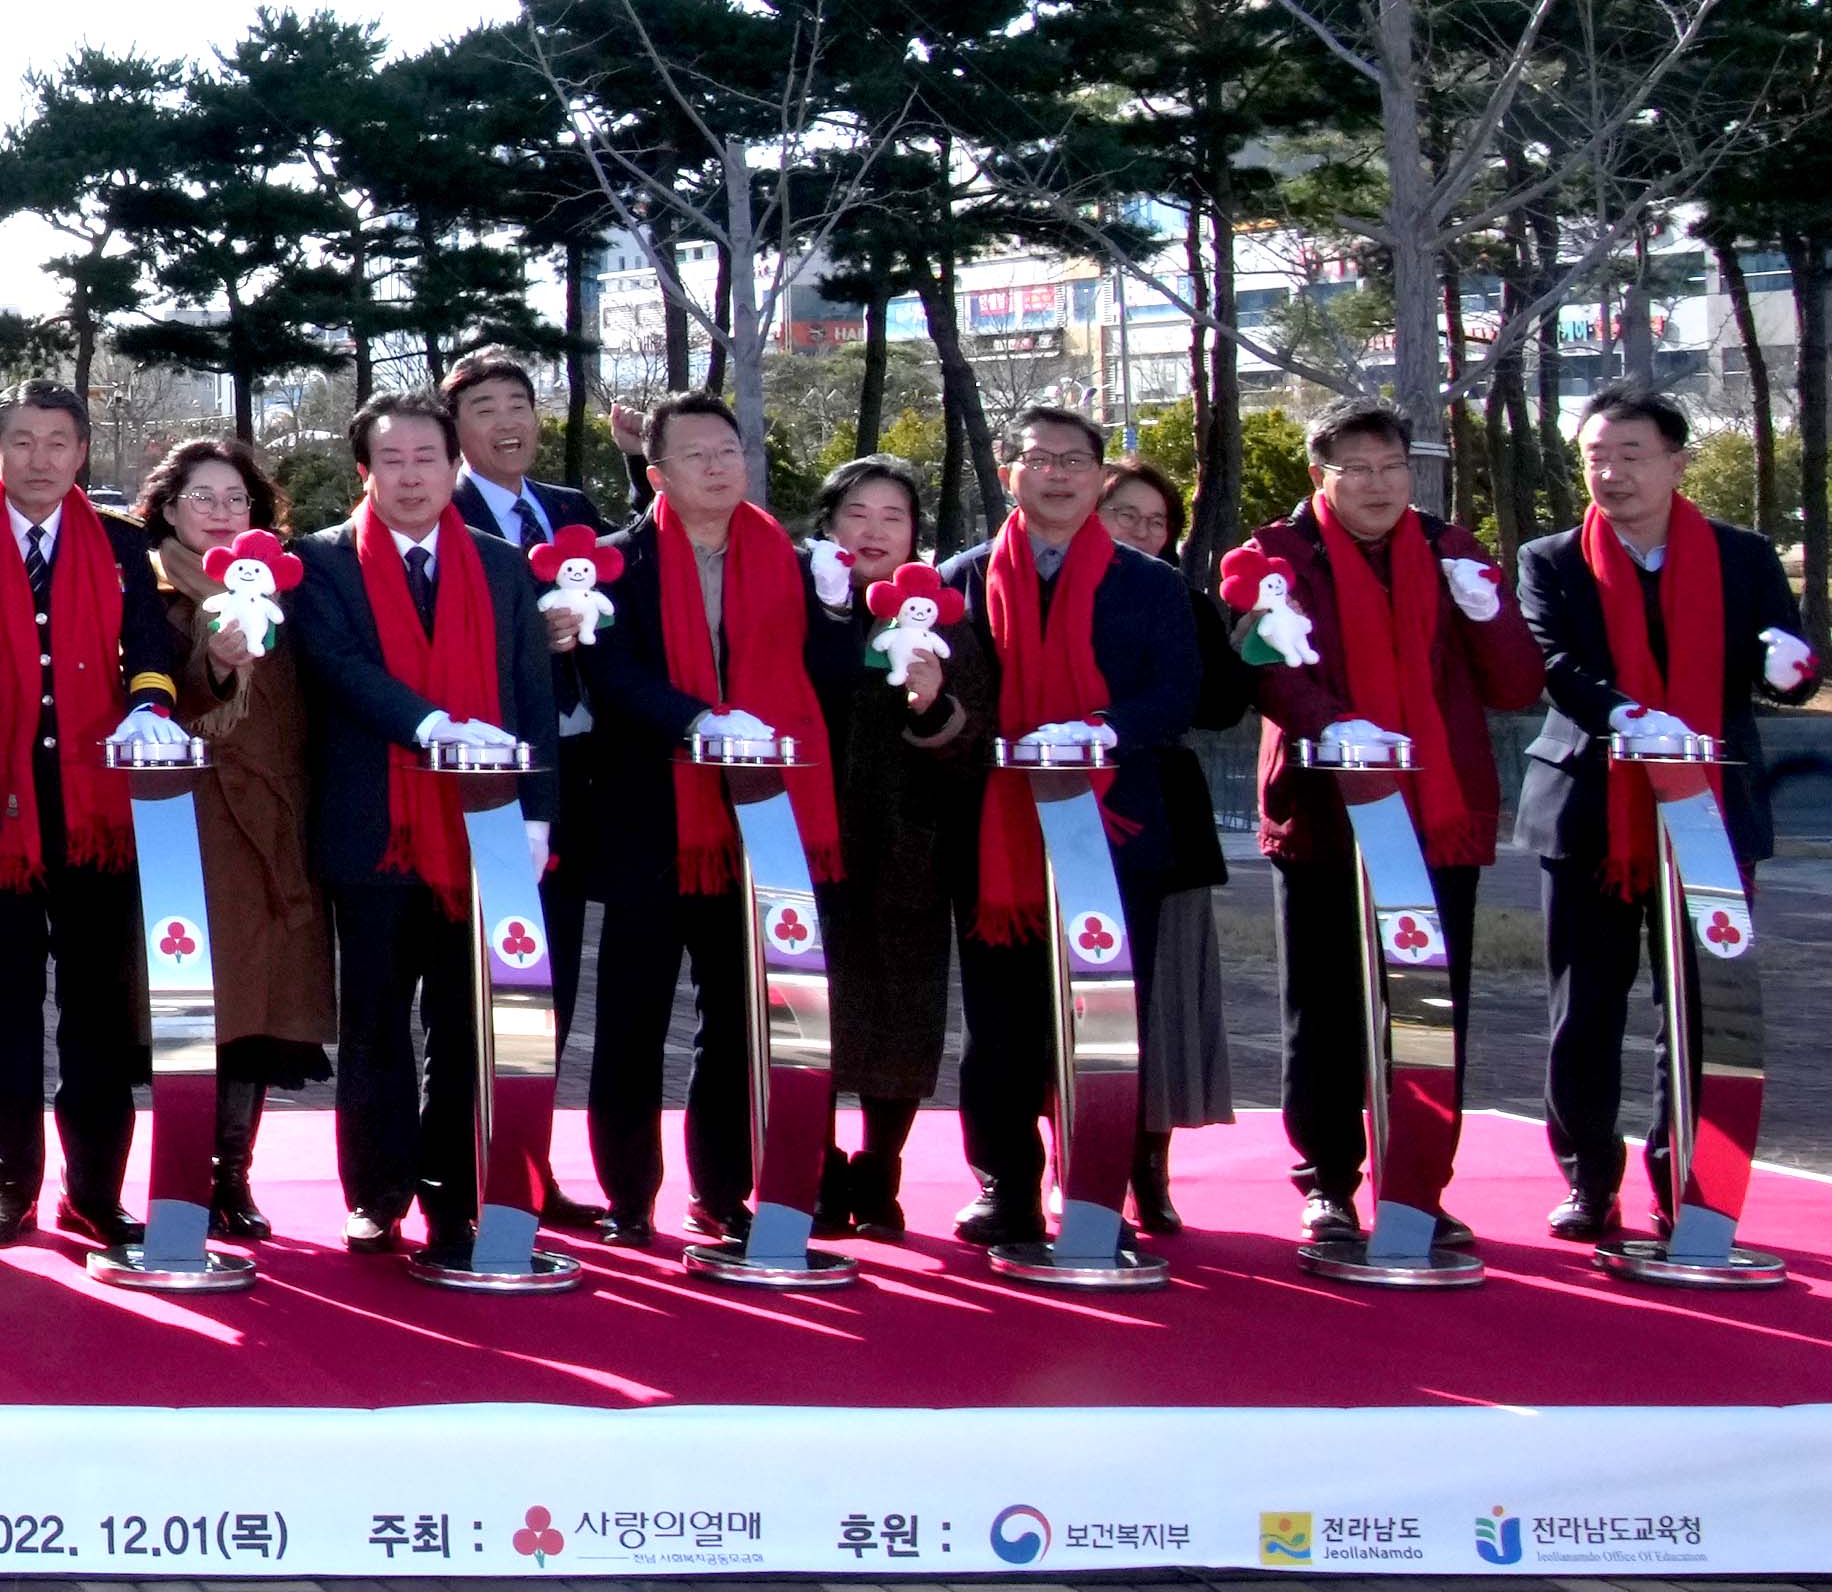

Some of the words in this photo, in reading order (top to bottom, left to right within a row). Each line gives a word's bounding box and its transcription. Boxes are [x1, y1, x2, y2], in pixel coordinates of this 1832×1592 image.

[100, 1511, 289, 1561] 12.01(목)
[368, 1514, 452, 1560] 주최
[575, 1511, 762, 1550] 사랑의열매
[838, 1514, 921, 1560] 후원
[1066, 1524, 1191, 1551] 보건복지부
[1322, 1518, 1423, 1543] 전라남도
[1533, 1516, 1702, 1545] 전라남도교육청
[1324, 1547, 1424, 1560] JeollaNamdo
